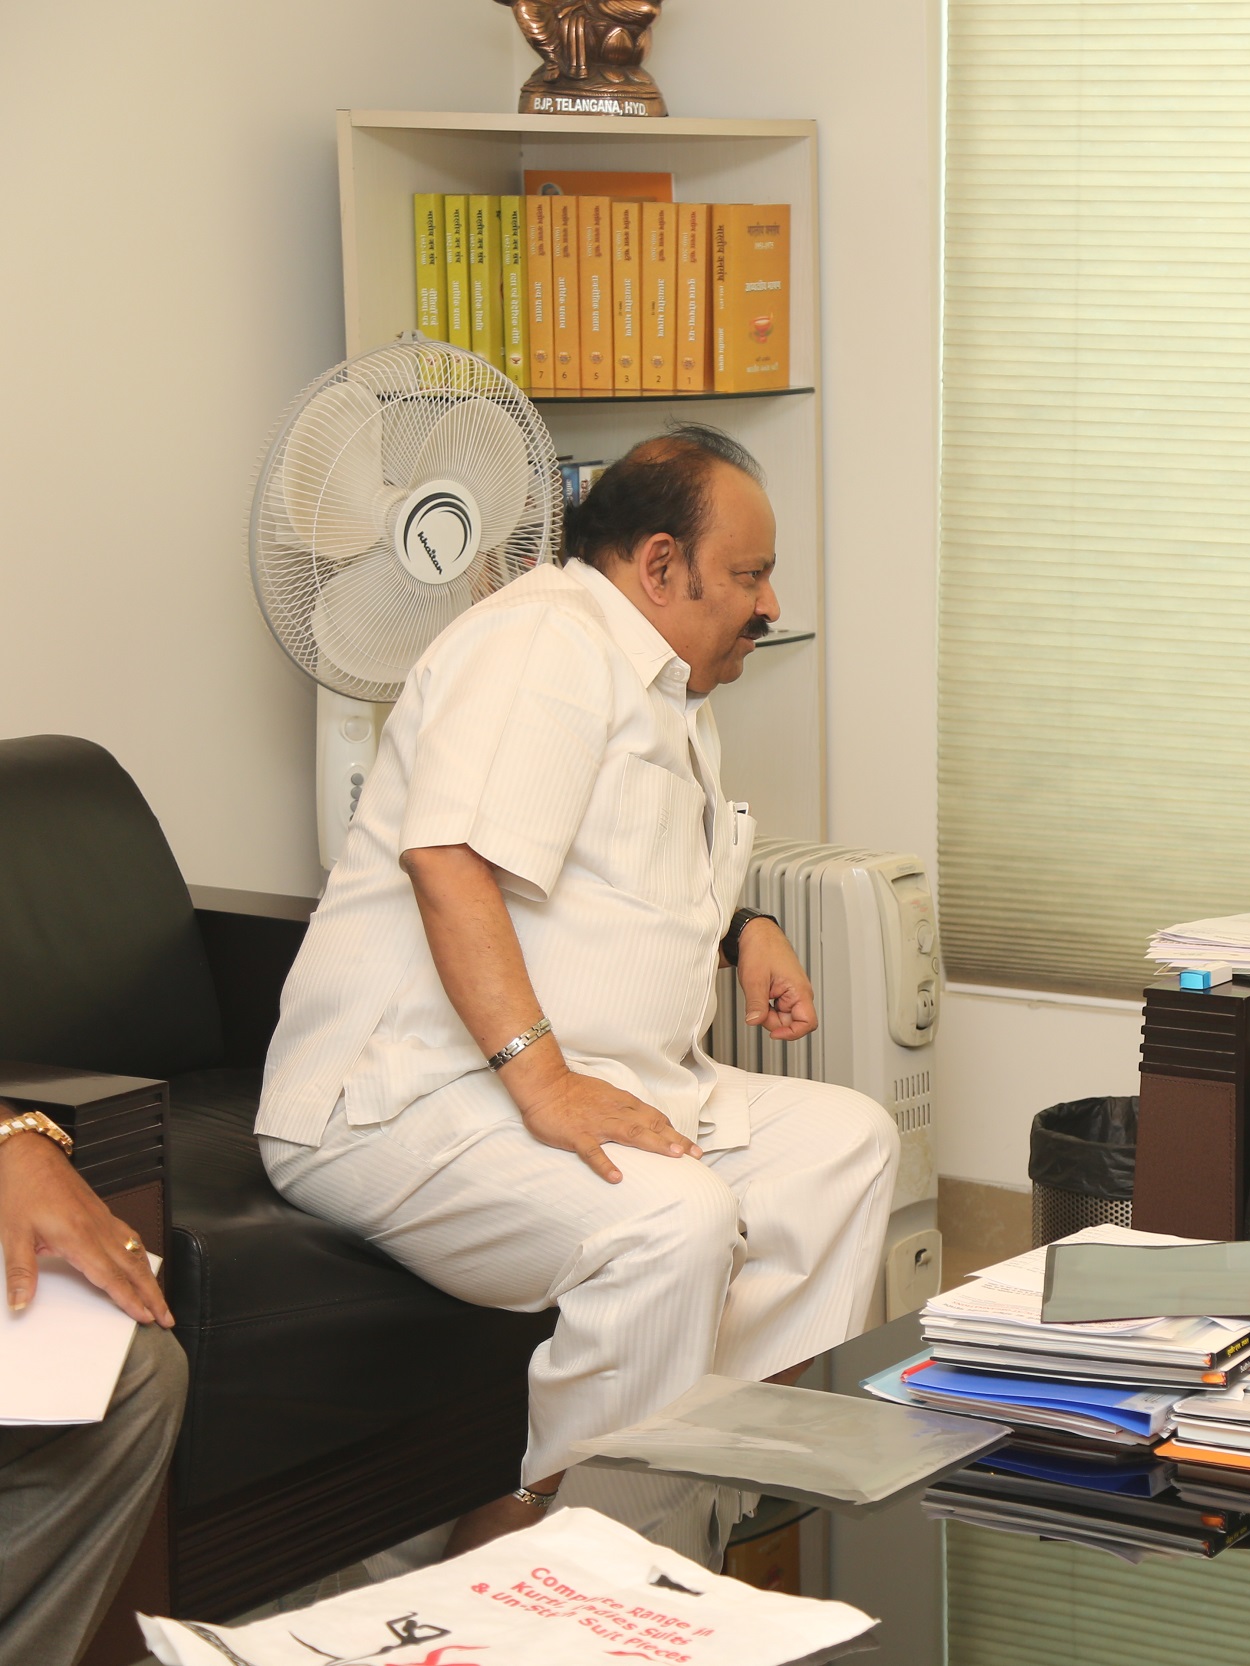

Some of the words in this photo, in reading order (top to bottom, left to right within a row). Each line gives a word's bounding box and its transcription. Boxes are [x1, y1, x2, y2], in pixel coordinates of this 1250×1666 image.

[534, 97, 554, 112] BJP,
[556, 98, 623, 115] TELANGANA,
[625, 101, 648, 116] HYD.
[427, 211, 436, 236] भारतीय
[453, 209, 462, 235] भारतीय
[476, 210, 485, 235] भारतीय
[511, 211, 520, 236] भारतीय
[716, 225, 727, 254] भारतीय
[429, 253, 437, 265] संघ
[455, 251, 463, 263] संघ
[478, 252, 486, 264] संघ
[513, 253, 522, 265] संघ
[716, 256, 727, 282] जनसंघ
[539, 370, 544, 379] 7
[594, 372, 599, 380] 5
[624, 375, 630, 383] 3
[656, 375, 662, 383] 2
[471, 1582, 490, 1595] &
[578, 1617, 624, 1642] Suit
[623, 1637, 693, 1663] Pieces
[626, 1607, 692, 1630] Range
